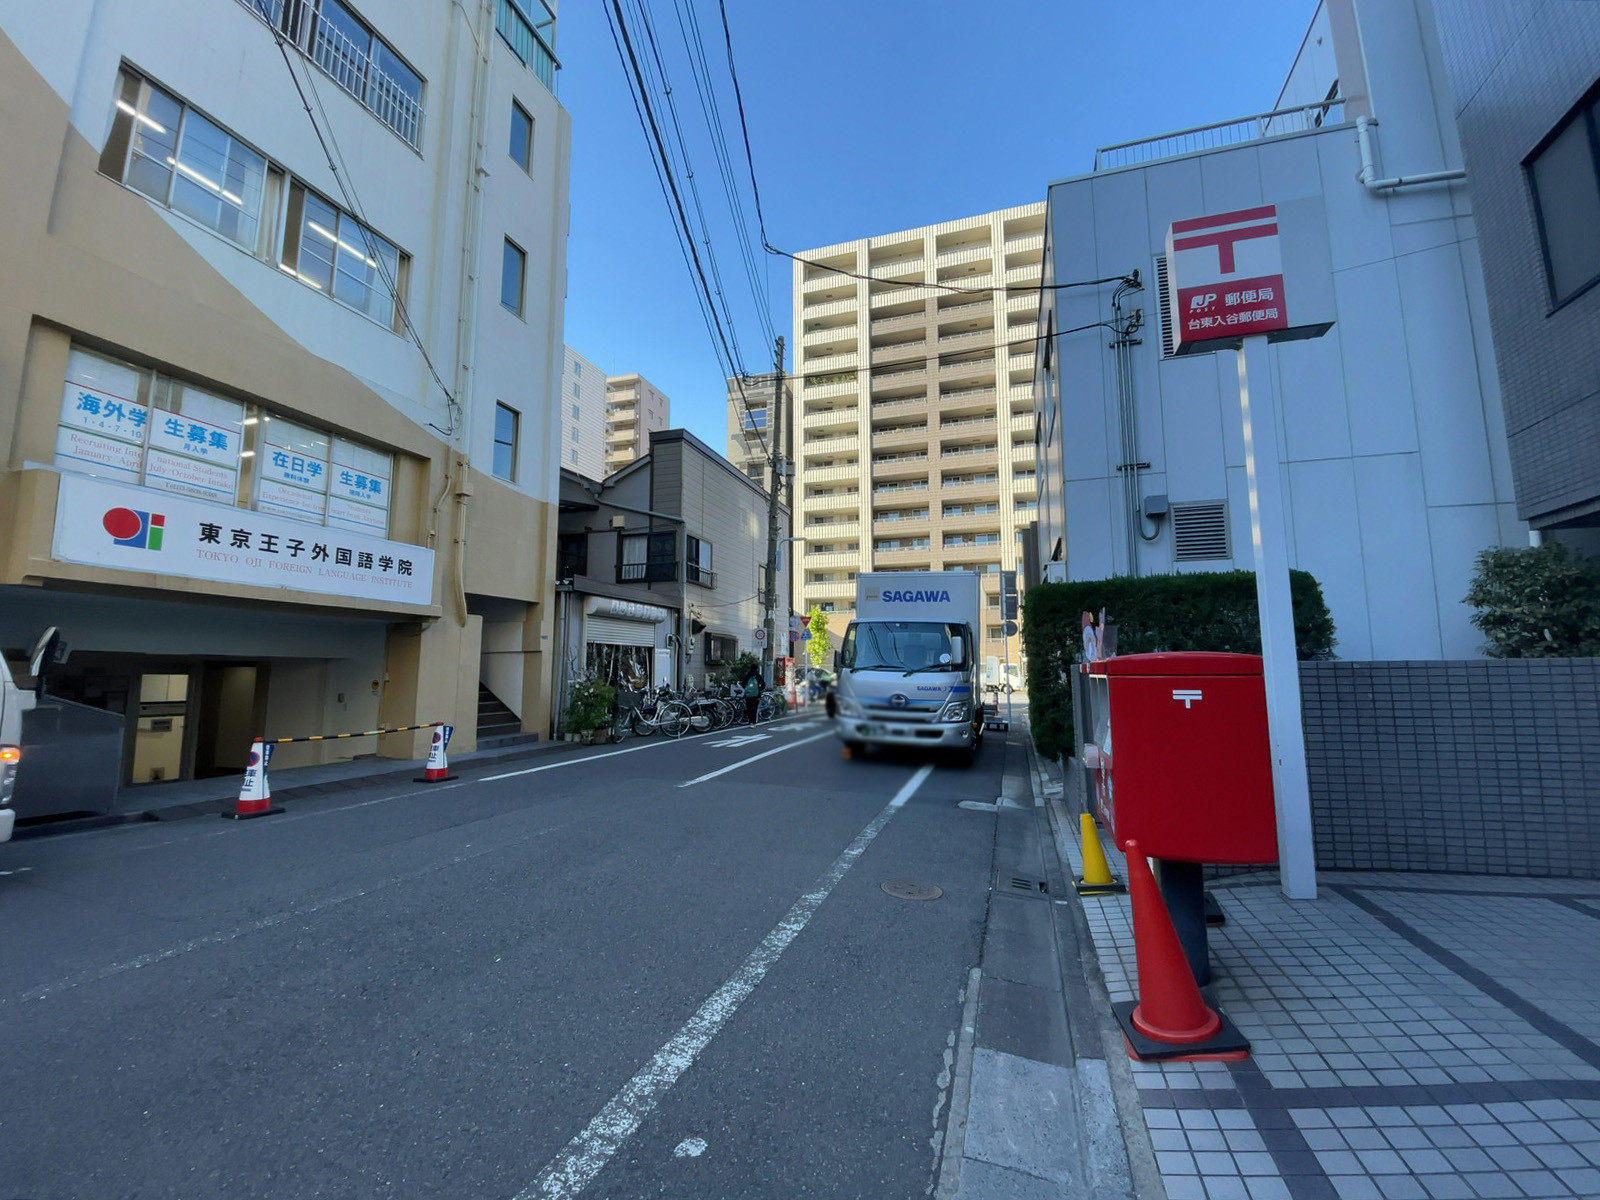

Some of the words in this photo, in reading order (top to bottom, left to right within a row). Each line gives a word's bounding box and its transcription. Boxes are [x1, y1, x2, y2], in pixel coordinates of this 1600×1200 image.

[1189, 306, 1216, 314] POST
[1225, 287, 1274, 306] 郵便局
[1188, 308, 1278, 330] 台東入谷郵便局
[76, 391, 147, 427] 海外学
[164, 417, 228, 451] 生募集
[70, 433, 122, 455] Recruiting
[192, 463, 228, 479] Students
[272, 451, 322, 478] 在日学
[339, 471, 382, 495] 生募集
[196, 549, 239, 564] TOKYO
[245, 557, 262, 569] OJI
[268, 560, 313, 574] FOREIGN
[318, 567, 367, 582] LANGUAGE
[370, 576, 413, 589] INSTITUTE
[198, 522, 413, 577] 東京王子外国語学院
[882, 590, 951, 603] SAGAWA
